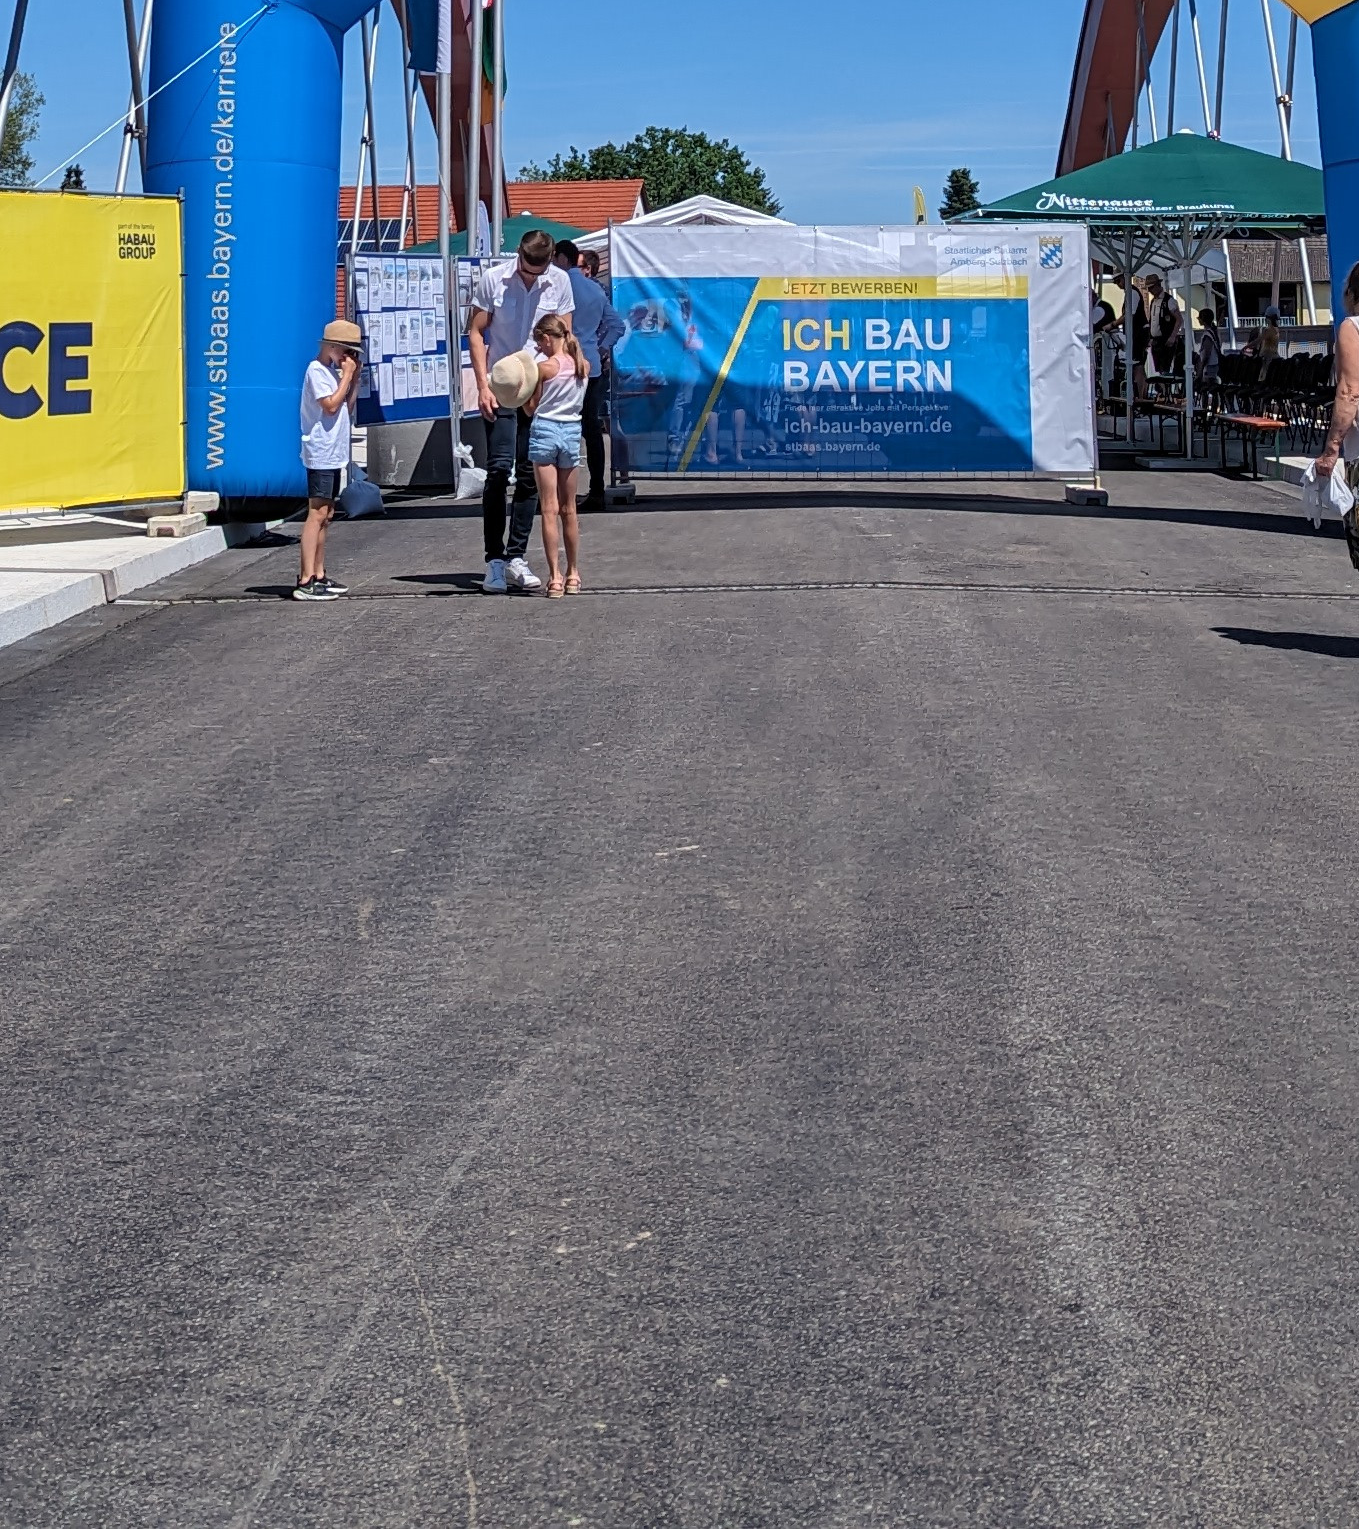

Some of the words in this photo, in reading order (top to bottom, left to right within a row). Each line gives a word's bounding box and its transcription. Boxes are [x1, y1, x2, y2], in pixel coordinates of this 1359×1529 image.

[1036, 191, 1153, 210] Nittenauer
[117, 233, 156, 246] HABAU
[204, 21, 238, 471] www.stbaas.bayern.de/karriere
[118, 246, 156, 260] GROUP
[944, 246, 991, 255] Staatliches
[950, 257, 1027, 267] Amberg-Sulzbach
[783, 283, 826, 295] JETZT
[831, 282, 918, 294] BEWERBEN!
[782, 318, 850, 351] ICH
[865, 318, 951, 351] BAU
[783, 360, 952, 392] BAYERN
[784, 417, 952, 437] ich-bau-bayern.de
[785, 441, 881, 453] stbaas.bayern.de
